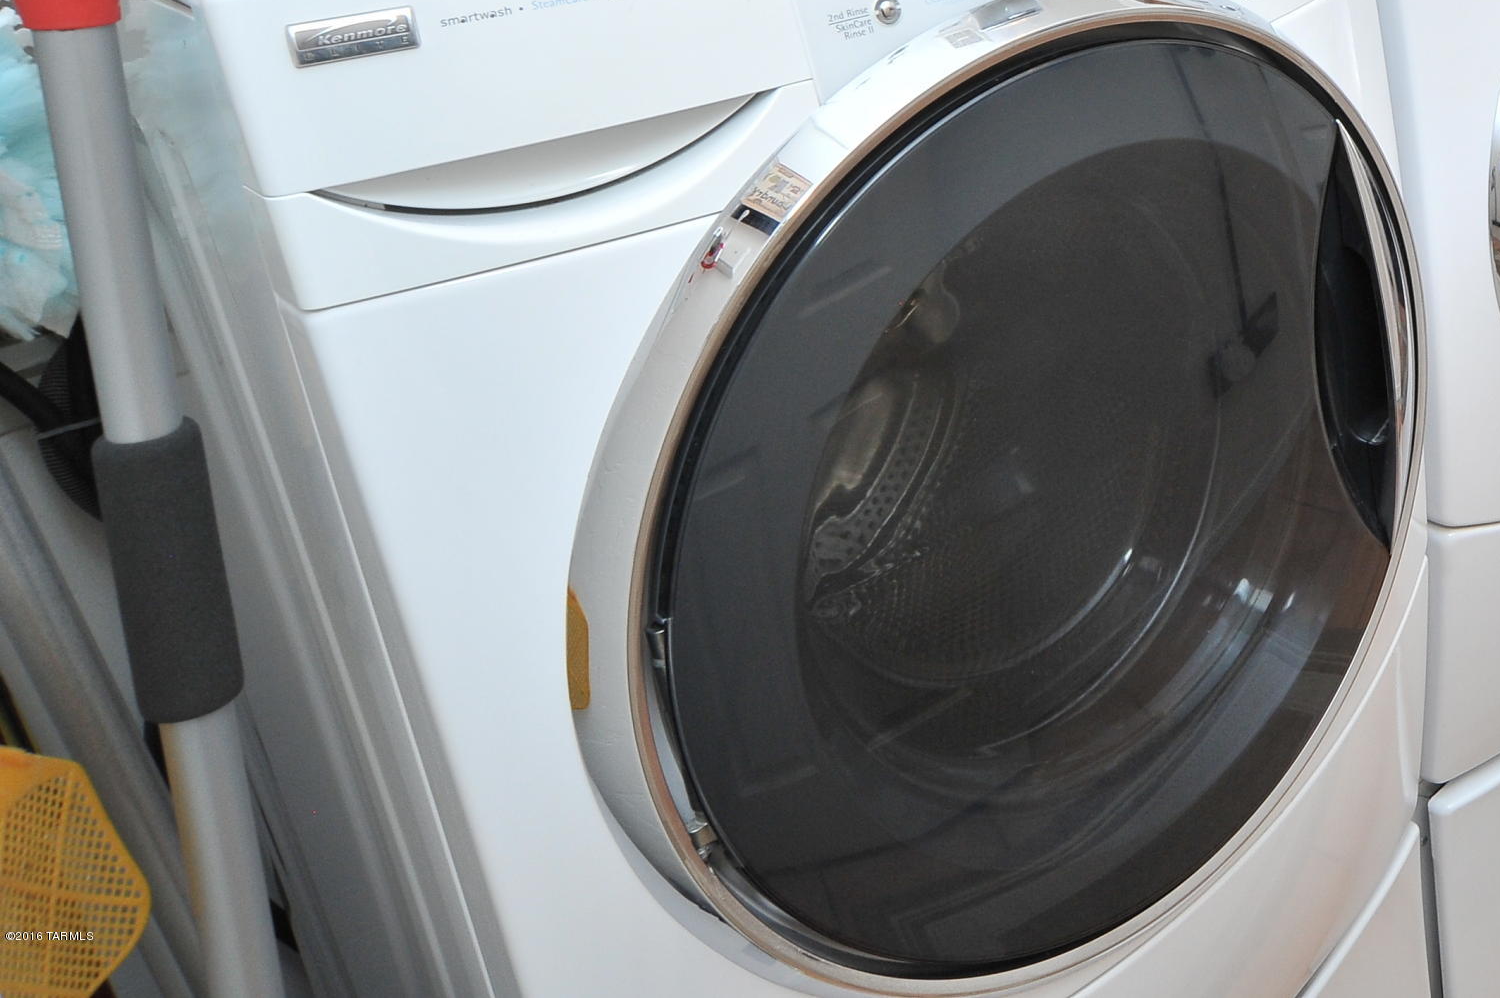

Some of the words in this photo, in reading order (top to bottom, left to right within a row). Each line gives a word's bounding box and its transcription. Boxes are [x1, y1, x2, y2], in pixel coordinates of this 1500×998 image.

[440, 5, 513, 28] smartwash
[828, 12, 841, 23] 2nd
[846, 7, 868, 19] Rinse
[318, 22, 407, 46] Kenmore
[835, 19, 872, 33] SkinCare
[844, 29, 867, 41] Rinse
